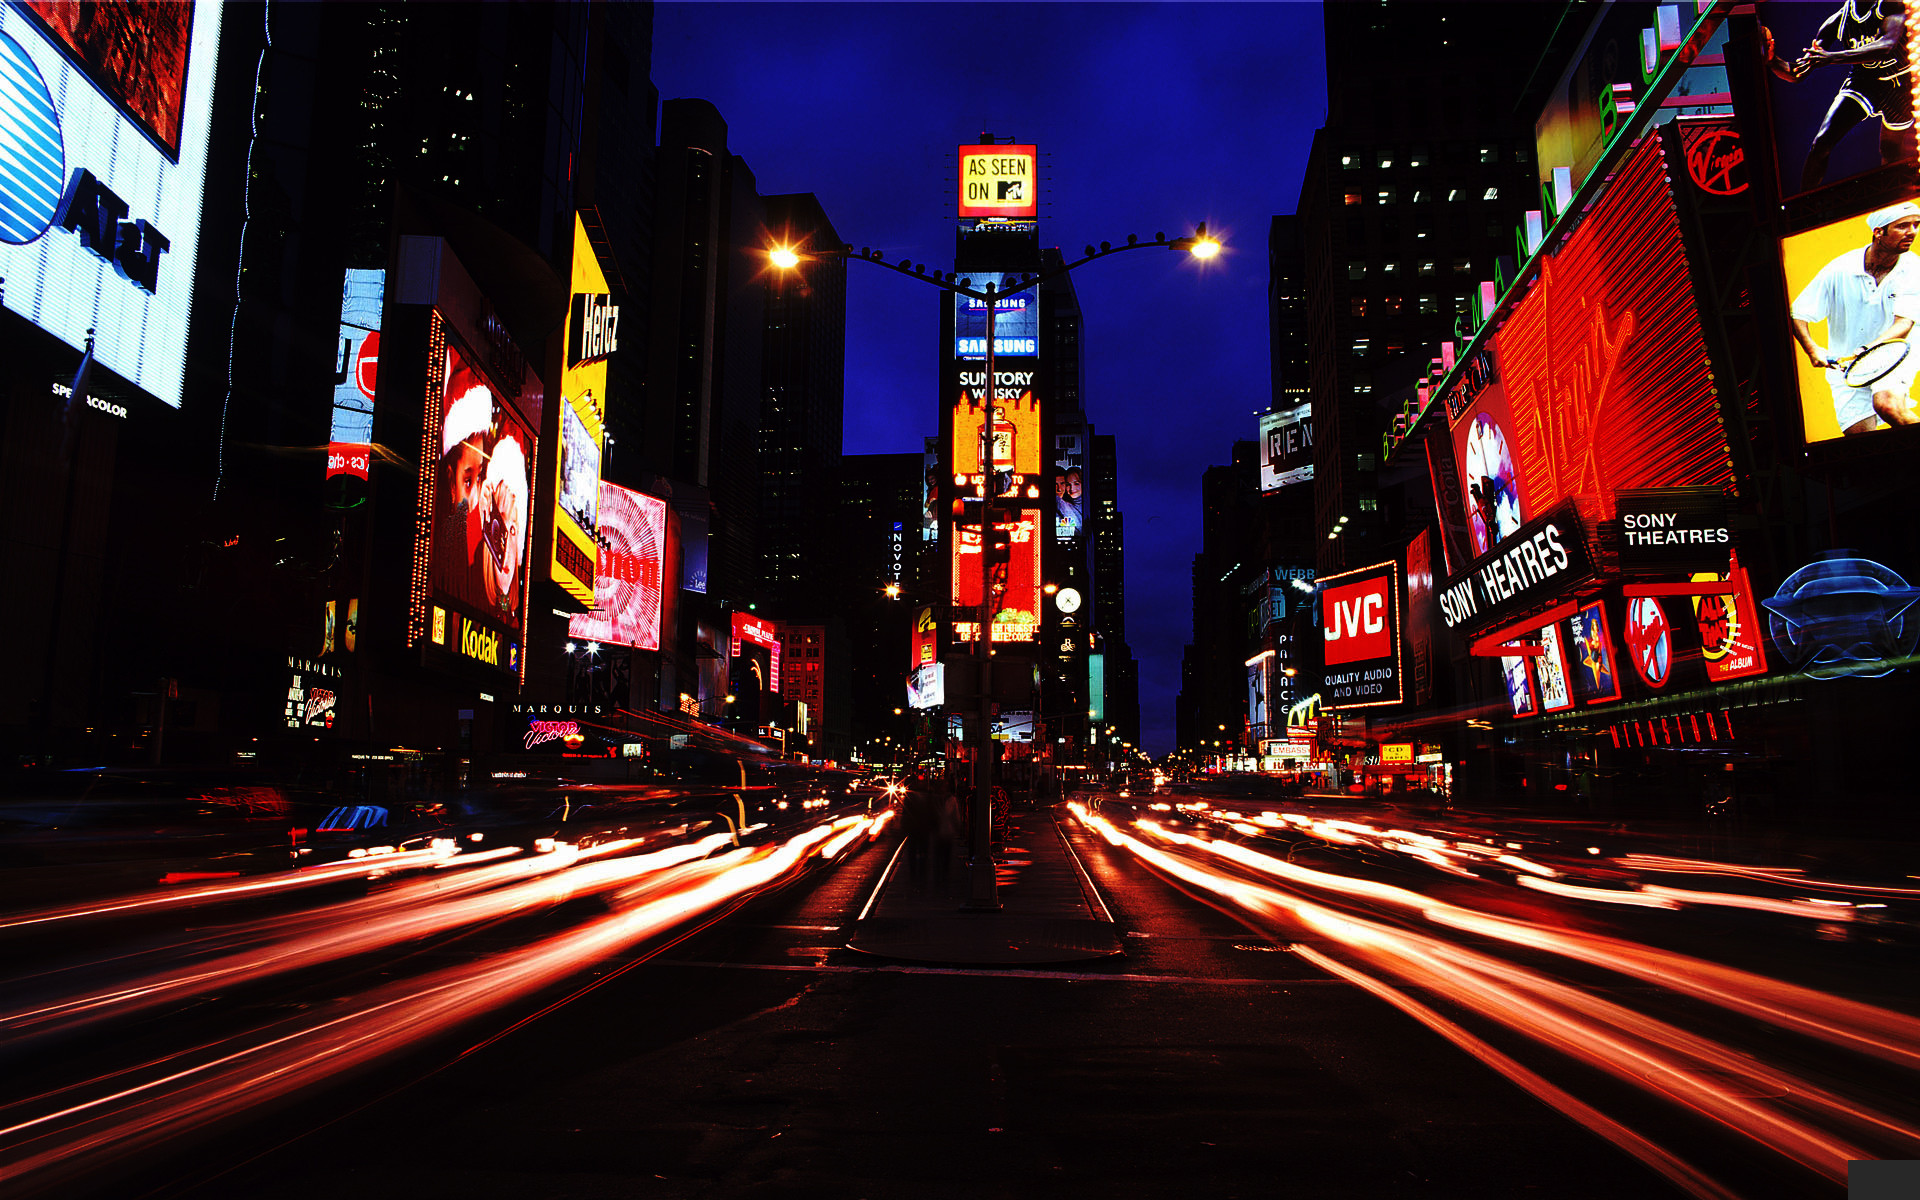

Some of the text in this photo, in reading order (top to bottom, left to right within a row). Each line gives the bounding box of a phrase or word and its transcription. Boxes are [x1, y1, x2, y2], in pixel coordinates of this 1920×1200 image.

[969, 159, 1026, 175] AS SEEN
[1693, 135, 1745, 184] Virgin
[969, 183, 989, 199] ON
[58, 167, 171, 296] AT&T
[969, 299, 1026, 308] SASUNG
[582, 293, 619, 360] Hertz
[971, 388, 1022, 400] WISKY
[1623, 513, 1677, 529] SONY
[1624, 528, 1729, 546] THEATRES
[1274, 568, 1315, 581] WEBB
[1439, 577, 1478, 628] SONY
[1324, 592, 1383, 641] JVC
[462, 617, 499, 666] Kodak
[1729, 656, 1753, 671] ALBUM
[1279, 634, 1290, 715] PALACE
[1325, 667, 1392, 686] QUALITY AUDIO
[1334, 683, 1383, 698] AND VIDEO
[512, 704, 602, 714] MARQUIS
[530, 721, 578, 733] VICTOR
